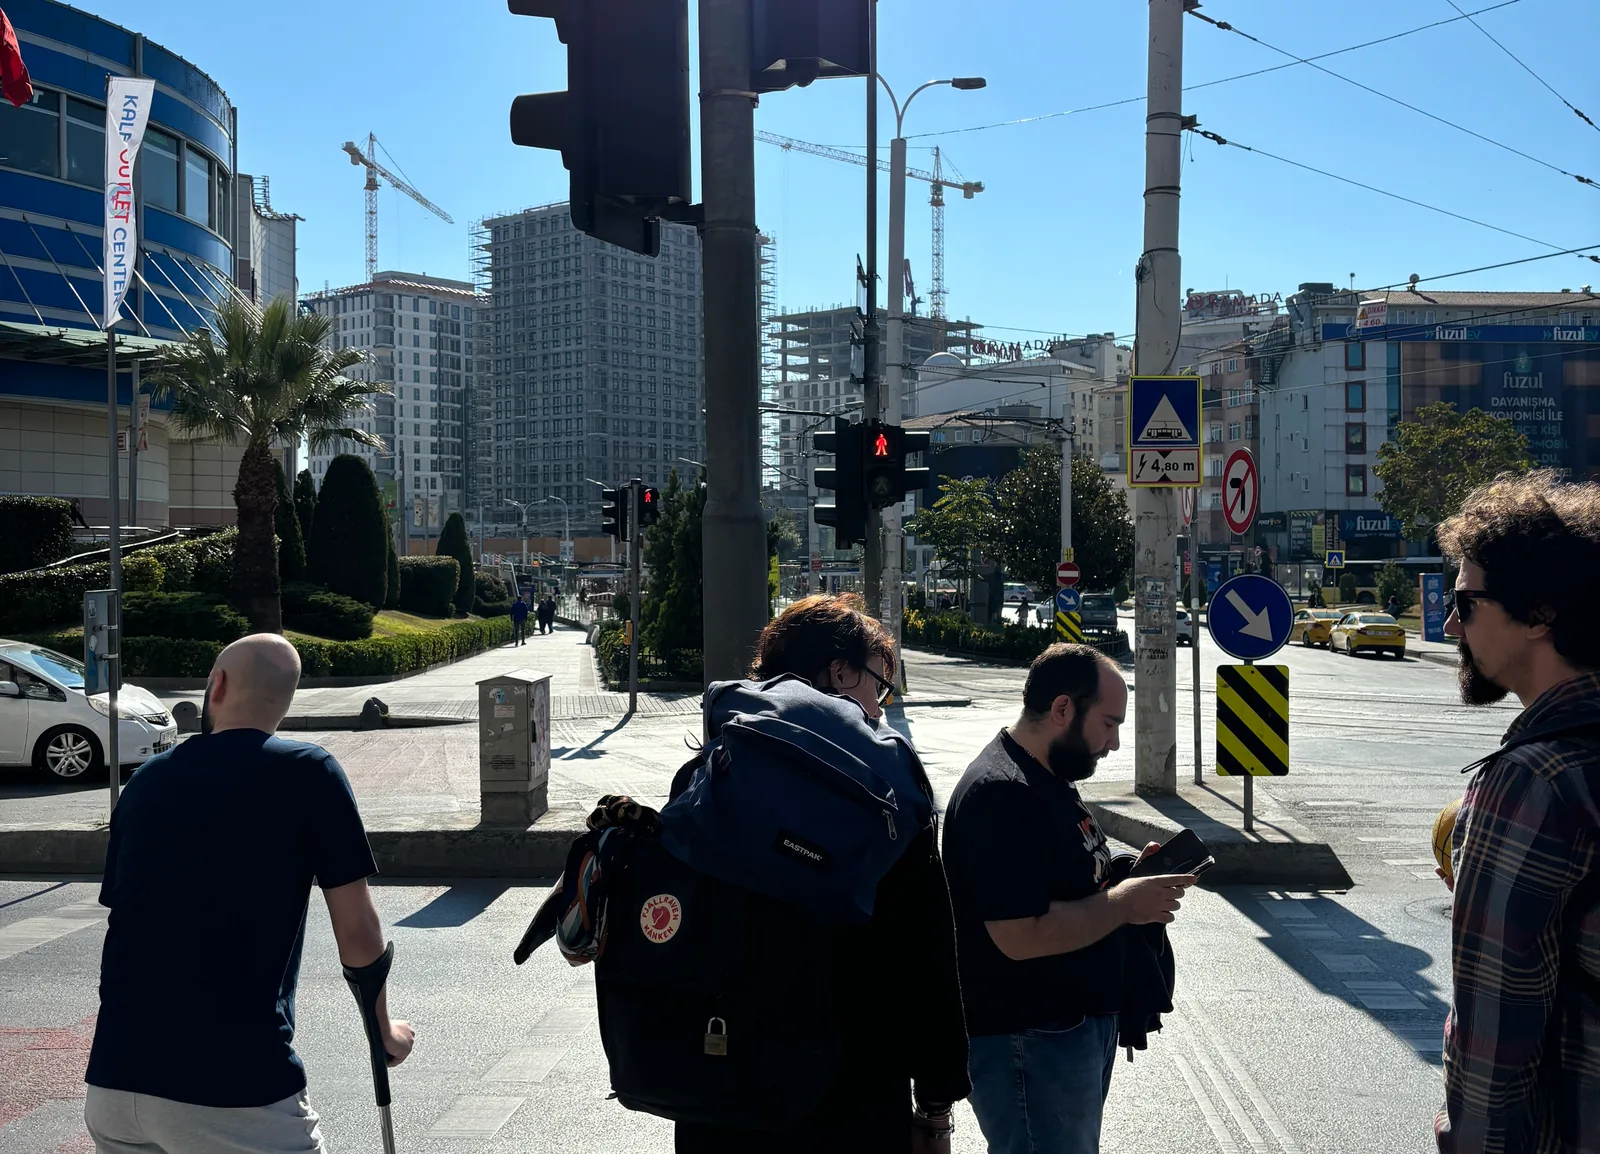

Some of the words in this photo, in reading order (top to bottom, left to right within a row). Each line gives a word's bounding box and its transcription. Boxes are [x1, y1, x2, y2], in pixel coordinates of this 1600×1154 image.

[1208, 291, 1282, 308] RAMADA
[1503, 371, 1544, 389] fuzul
[1491, 397, 1556, 410] DAYANIŞMA
[1548, 409, 1564, 421] İLE
[1151, 459, 1179, 473] 4,80
[1183, 462, 1195, 471] m
[783, 839, 821, 861] EASTPAK
